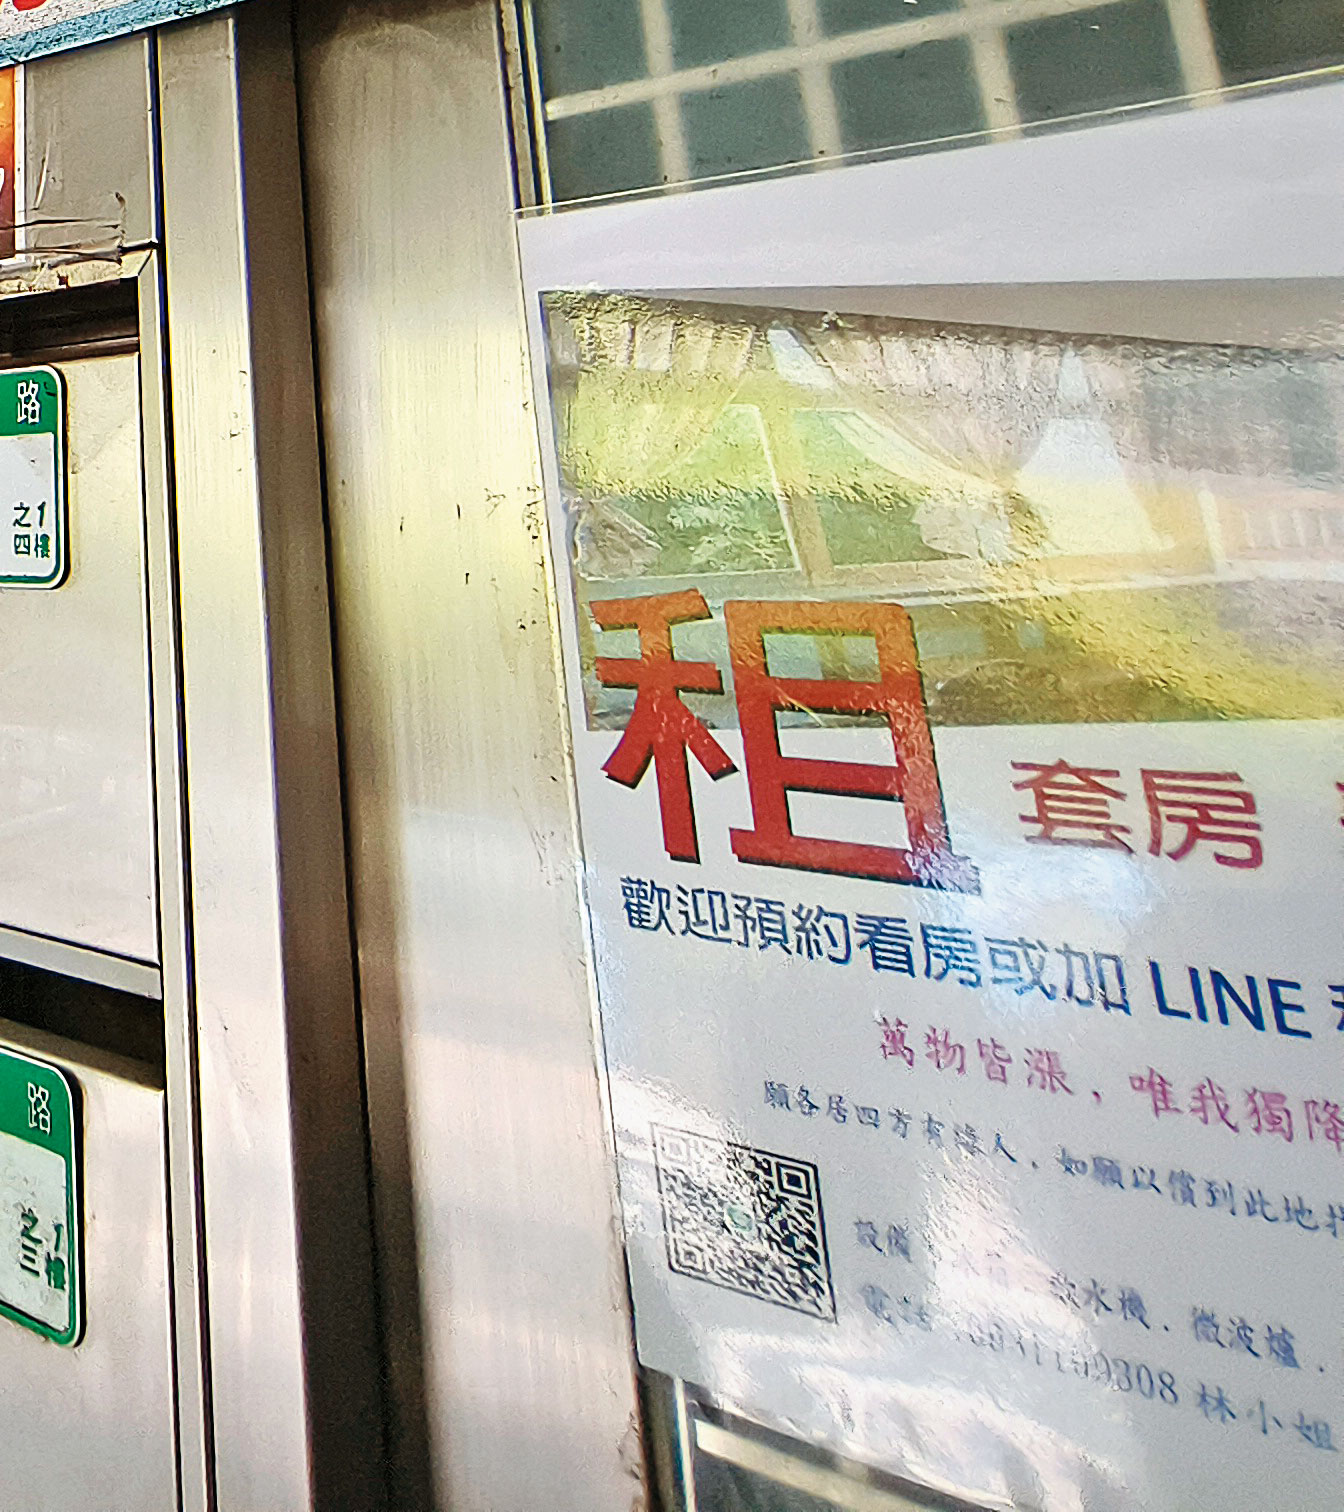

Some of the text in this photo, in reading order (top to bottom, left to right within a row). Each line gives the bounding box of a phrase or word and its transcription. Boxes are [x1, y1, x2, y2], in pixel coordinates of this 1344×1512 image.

[589, 587, 982, 896] 租
[1010, 757, 1263, 869] 套房
[1149, 959, 1313, 1039] LINE
[1199, 1383, 1337, 1452] 林小姐
